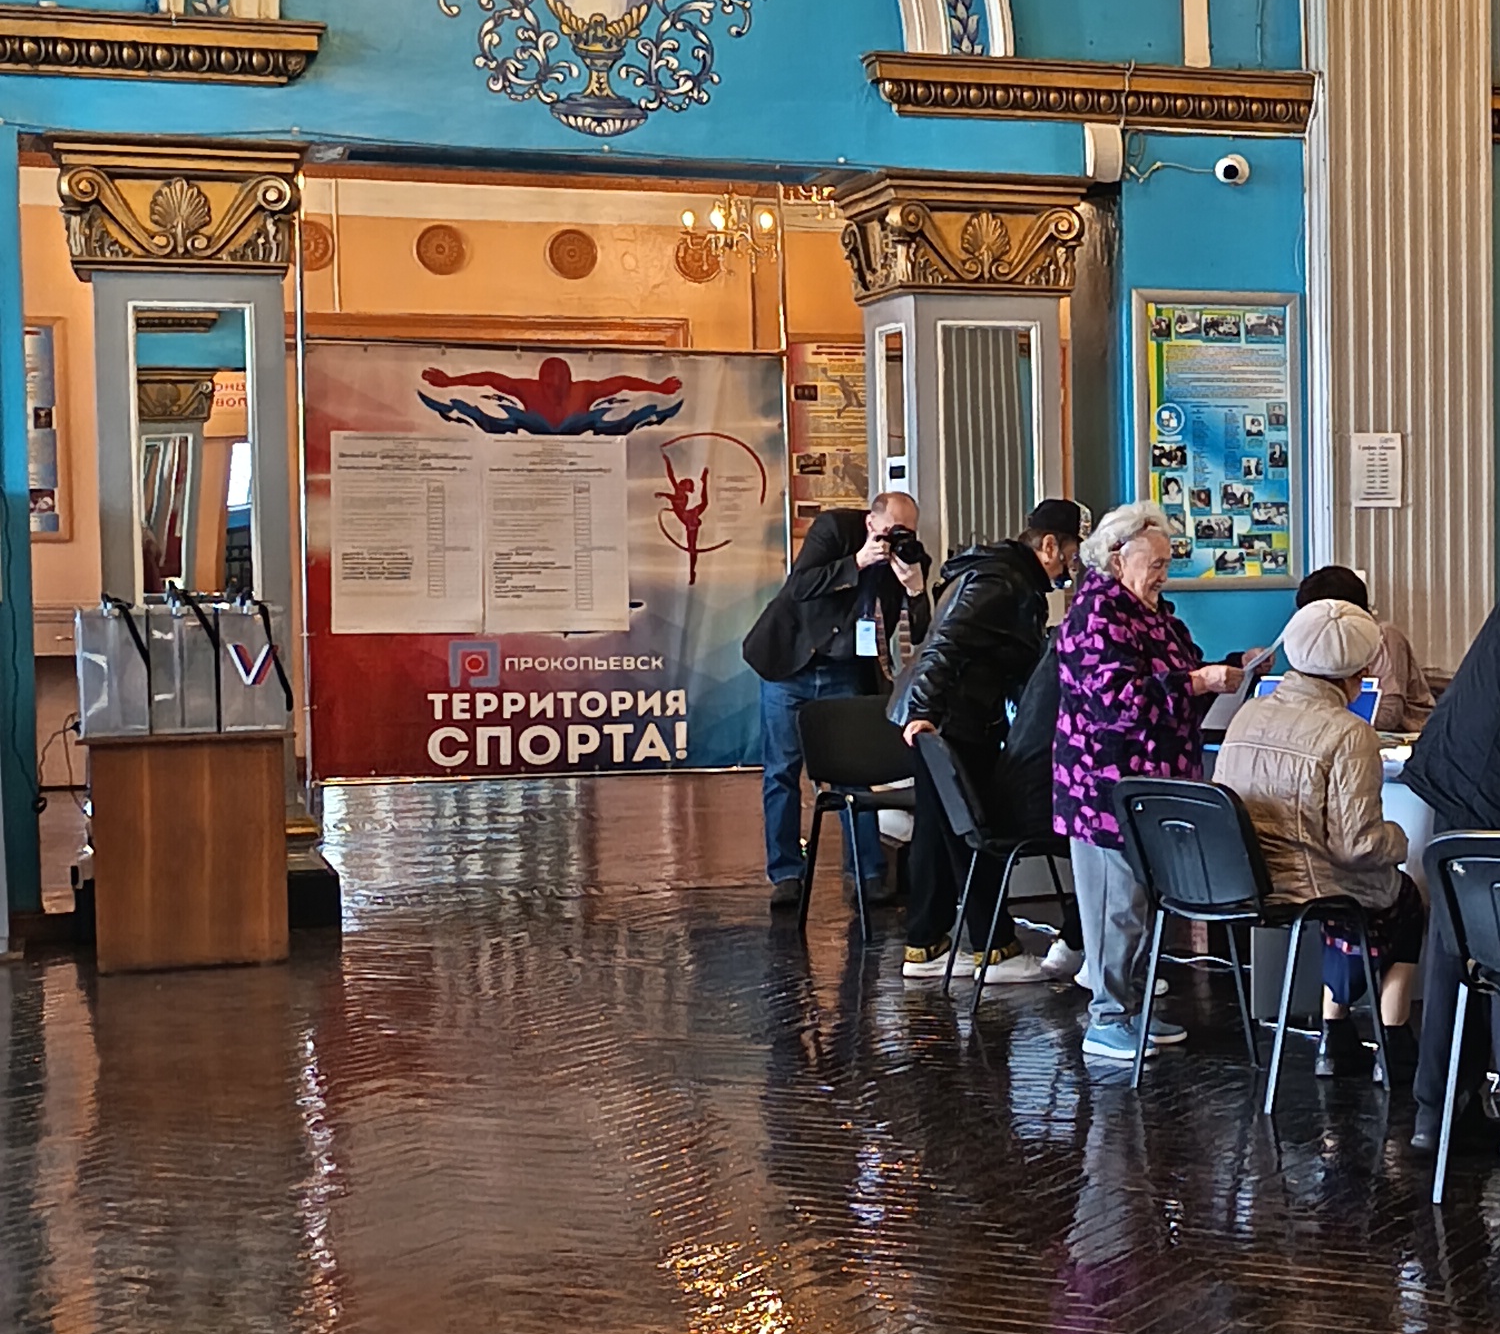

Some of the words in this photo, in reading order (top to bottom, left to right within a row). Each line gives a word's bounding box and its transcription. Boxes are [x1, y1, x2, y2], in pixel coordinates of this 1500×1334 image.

[504, 655, 664, 672] ПРОКОПЬЕВСК
[427, 688, 687, 720] ТЕРРИТОРИЯ
[427, 721, 688, 767] СПОРТА!
